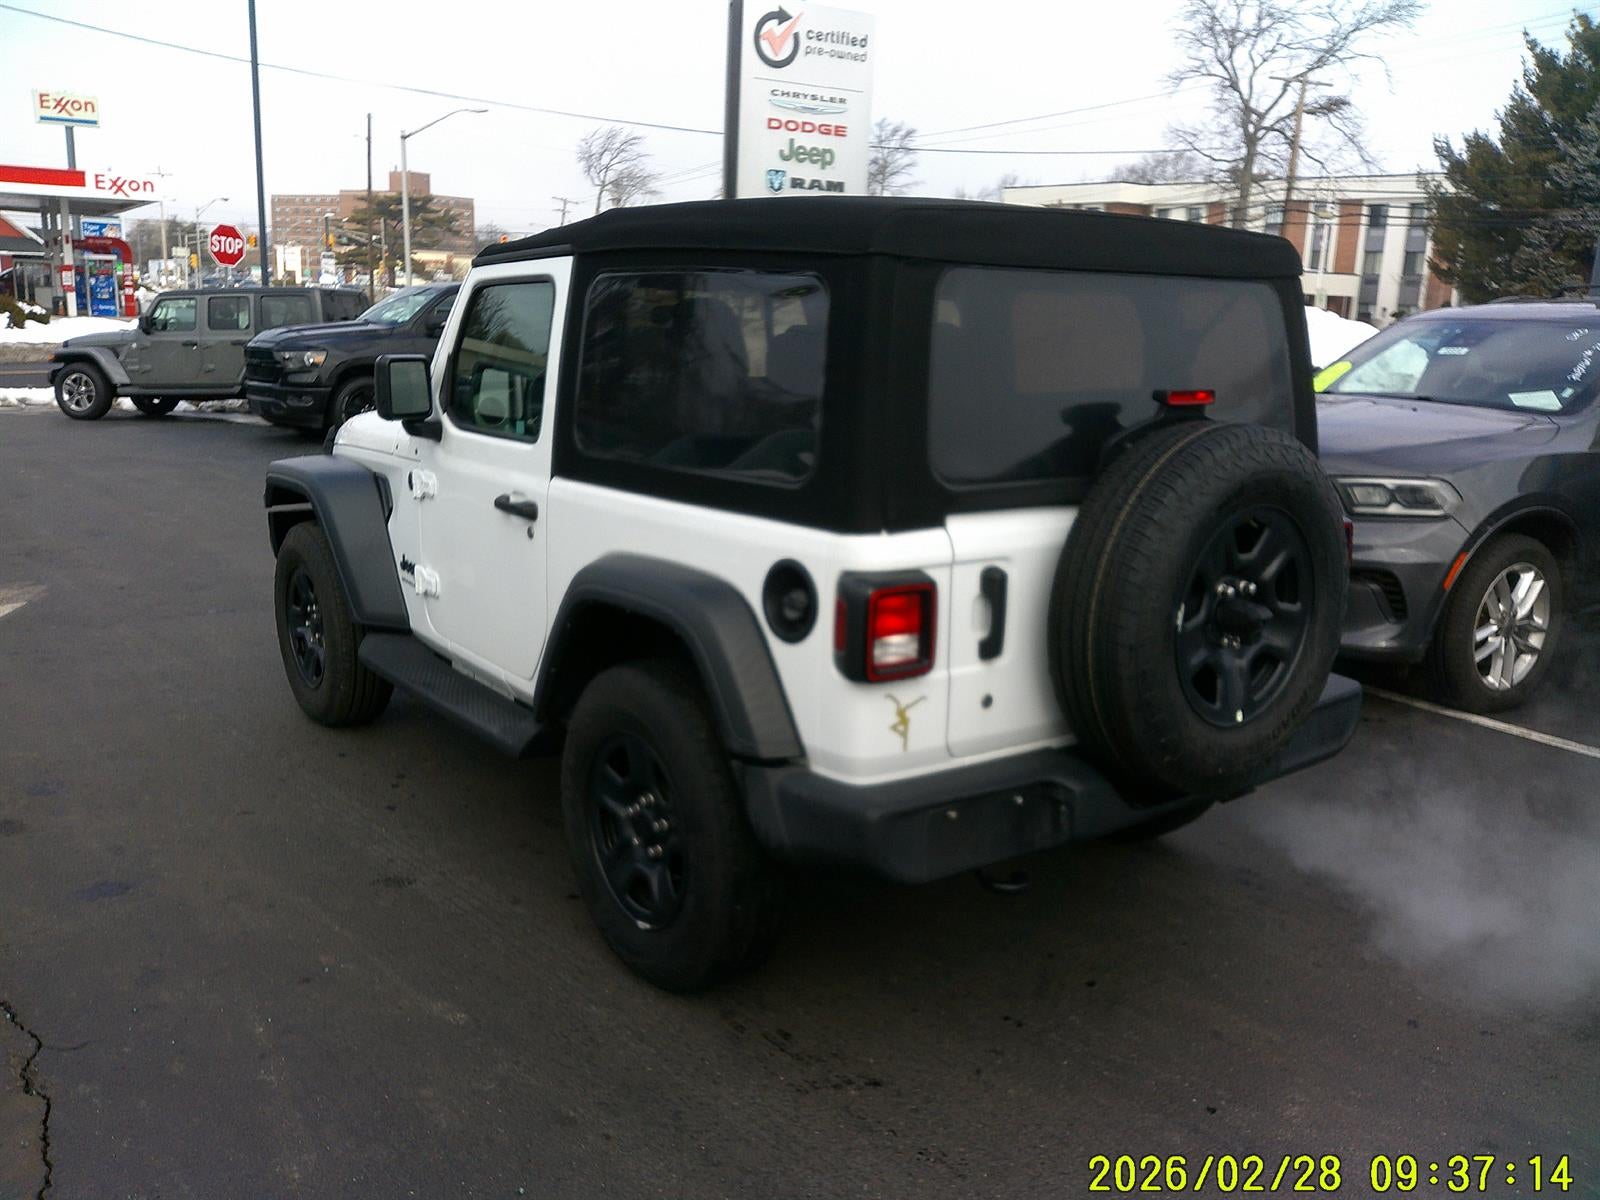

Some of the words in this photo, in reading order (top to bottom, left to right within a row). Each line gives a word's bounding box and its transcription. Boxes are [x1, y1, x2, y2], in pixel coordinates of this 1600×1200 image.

[805, 29, 868, 48] certified
[805, 45, 868, 62] pre-owned
[39, 93, 96, 116] Exxon
[770, 88, 847, 105] CHRYSLER
[767, 117, 848, 137] DODGE
[779, 138, 835, 170] Jeep
[94, 174, 154, 197] Exxon
[790, 177, 845, 193] RAM
[211, 234, 244, 255] STOP
